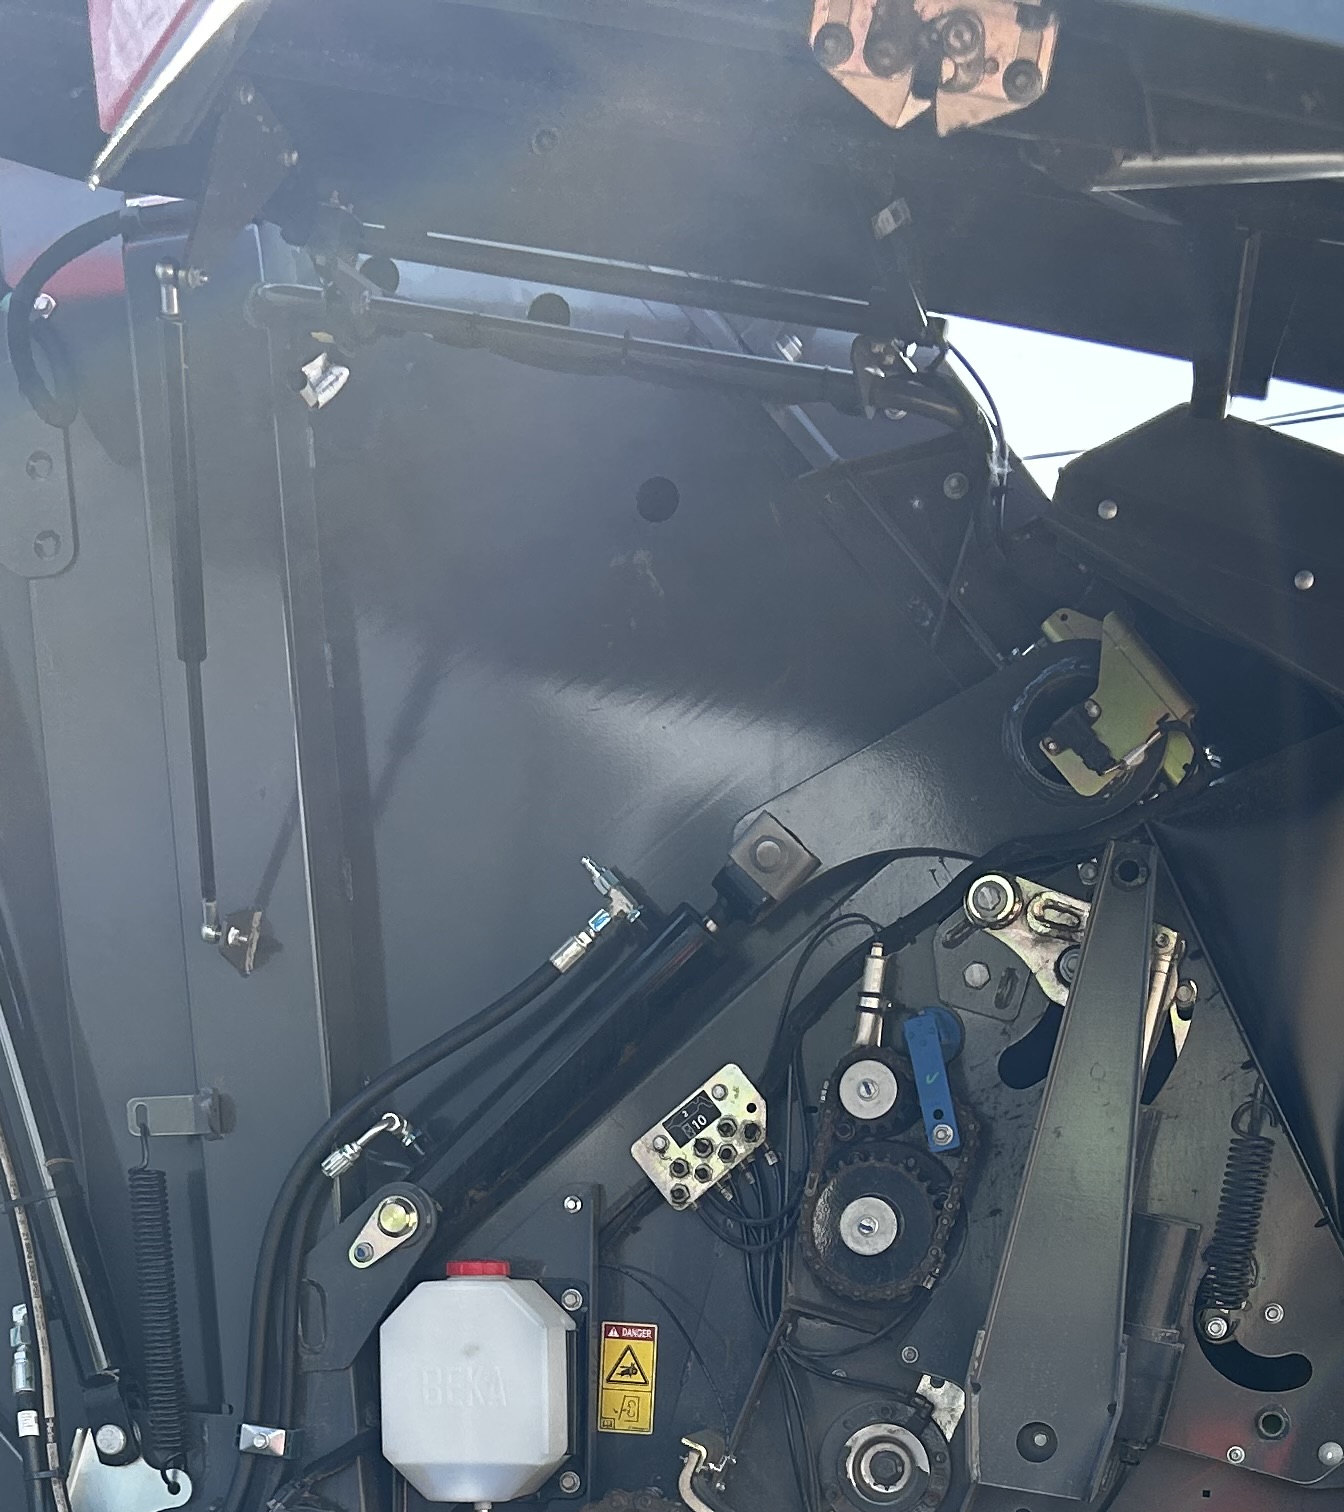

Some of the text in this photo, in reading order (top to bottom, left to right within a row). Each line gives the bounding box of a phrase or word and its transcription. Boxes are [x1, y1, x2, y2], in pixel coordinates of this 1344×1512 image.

[682, 1110, 689, 1118] 2
[691, 1114, 707, 1130] 10
[622, 1327, 652, 1339] DANGER
[421, 1364, 507, 1408] BEKA
